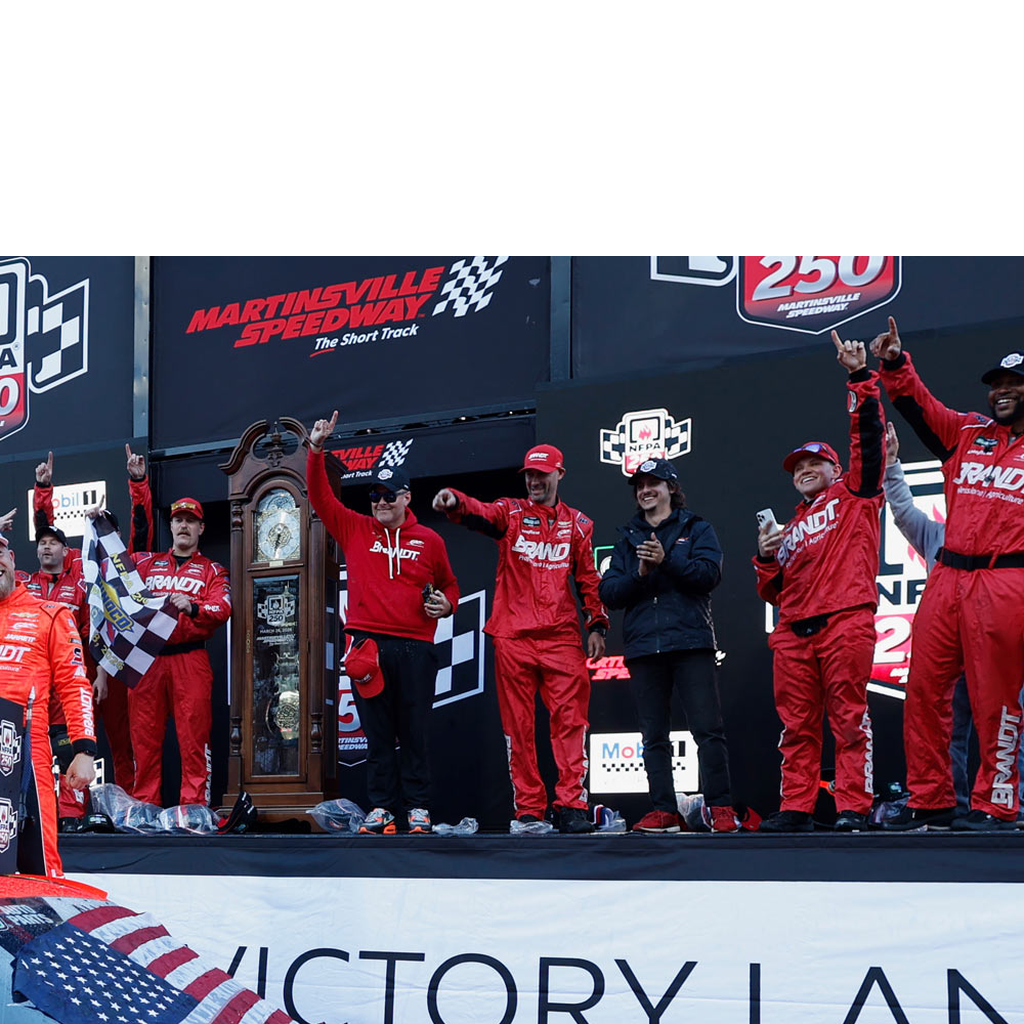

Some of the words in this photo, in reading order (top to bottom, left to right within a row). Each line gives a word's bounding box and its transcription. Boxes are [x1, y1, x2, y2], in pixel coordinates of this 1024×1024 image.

[752, 256, 887, 301] 250
[185, 266, 445, 334] MARTINSVILLE
[777, 293, 860, 312] MARTINSVILLE
[786, 303, 849, 319] SPEEDWAY
[233, 294, 432, 348] SPEEDWAY
[314, 337, 337, 350] The
[340, 330, 379, 347] Short
[380, 324, 418, 341] Track
[629, 442, 661, 453] NFPA
[953, 462, 1024, 493] RAND
[52, 492, 81, 509] obil
[512, 535, 570, 561] BRAND
[111, 553, 134, 589] NFPA
[146, 575, 205, 594] BRANDT
[875, 579, 926, 605] NF
[101, 645, 125, 670] 2026
[80, 687, 95, 736] BRANDT
[602, 743, 646, 759] Mob
[991, 706, 1022, 809] BRANDT
[7, 912, 54, 926] PARTS
